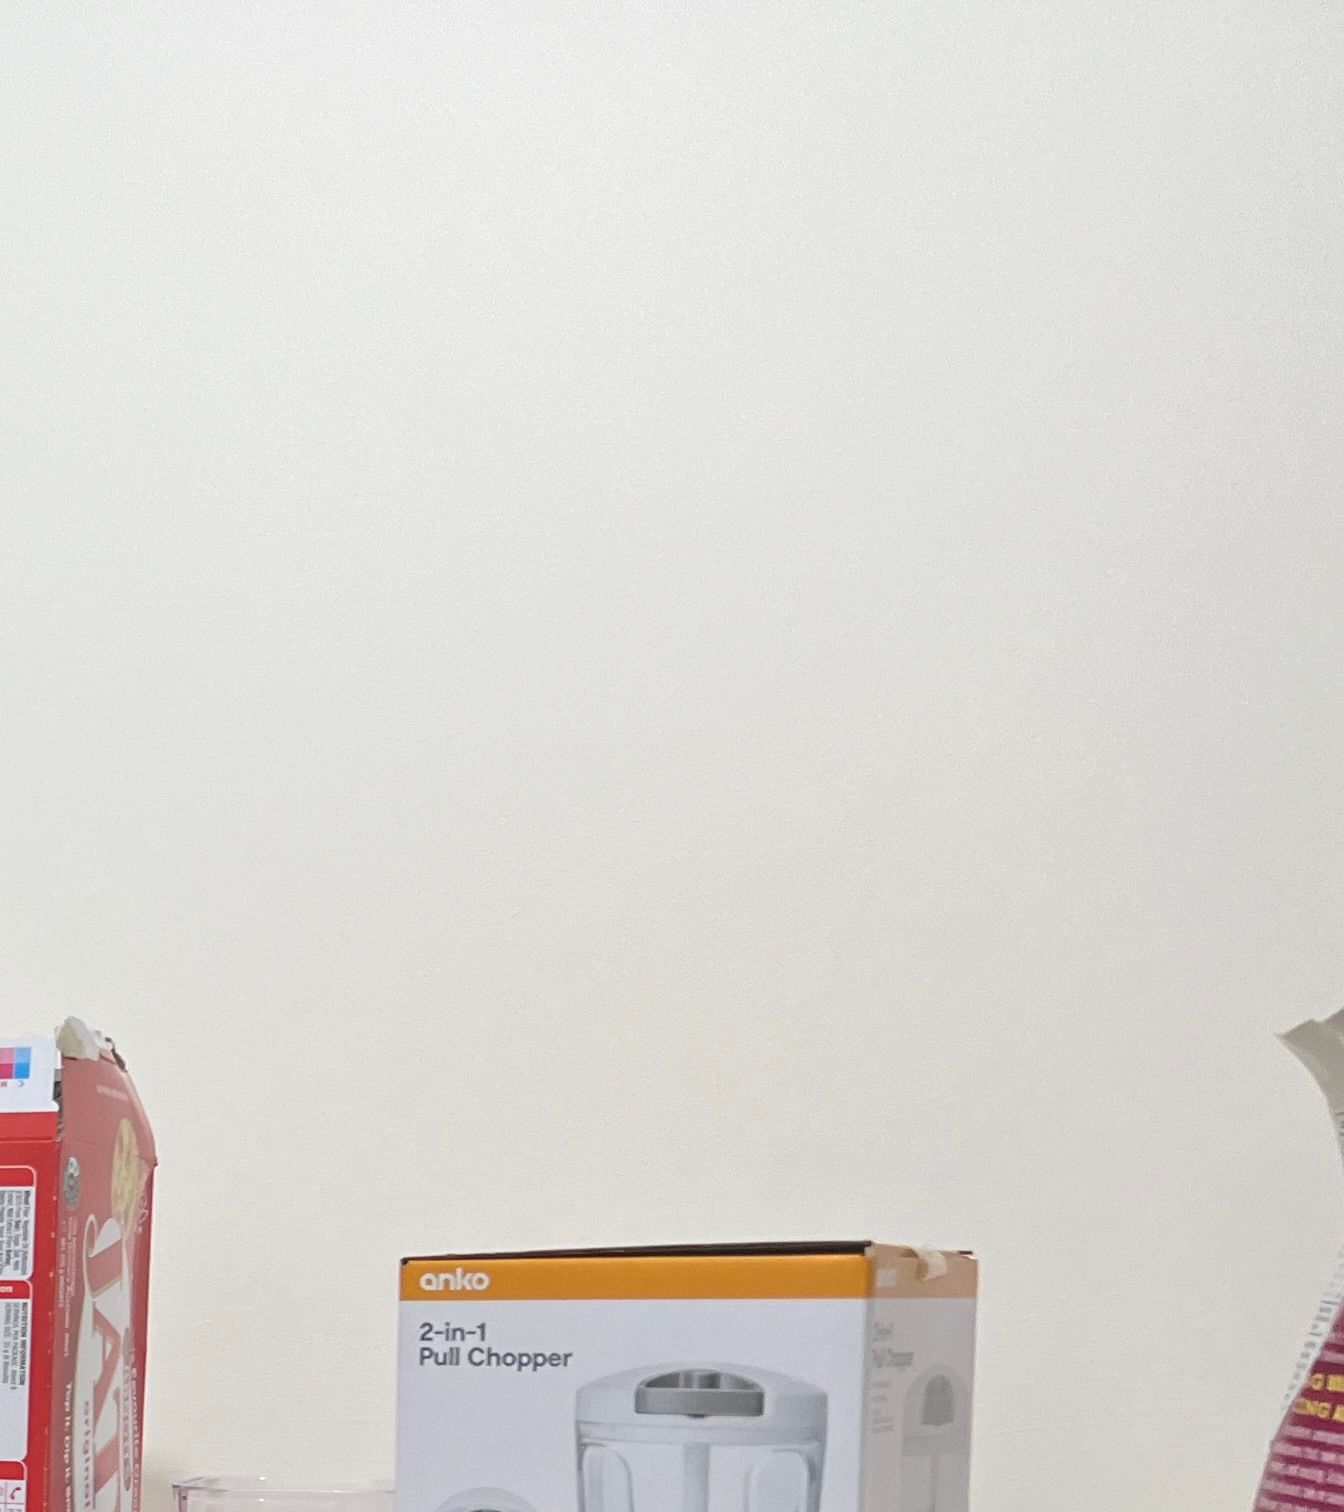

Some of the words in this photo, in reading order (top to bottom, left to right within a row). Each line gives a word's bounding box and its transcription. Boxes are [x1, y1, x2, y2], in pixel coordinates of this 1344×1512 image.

[419, 1267, 490, 1291] anko
[419, 1322, 487, 1341] 2-in-1
[419, 1347, 460, 1366] Pull
[467, 1346, 573, 1372] Chopper
[81, 1401, 90, 1509] original
